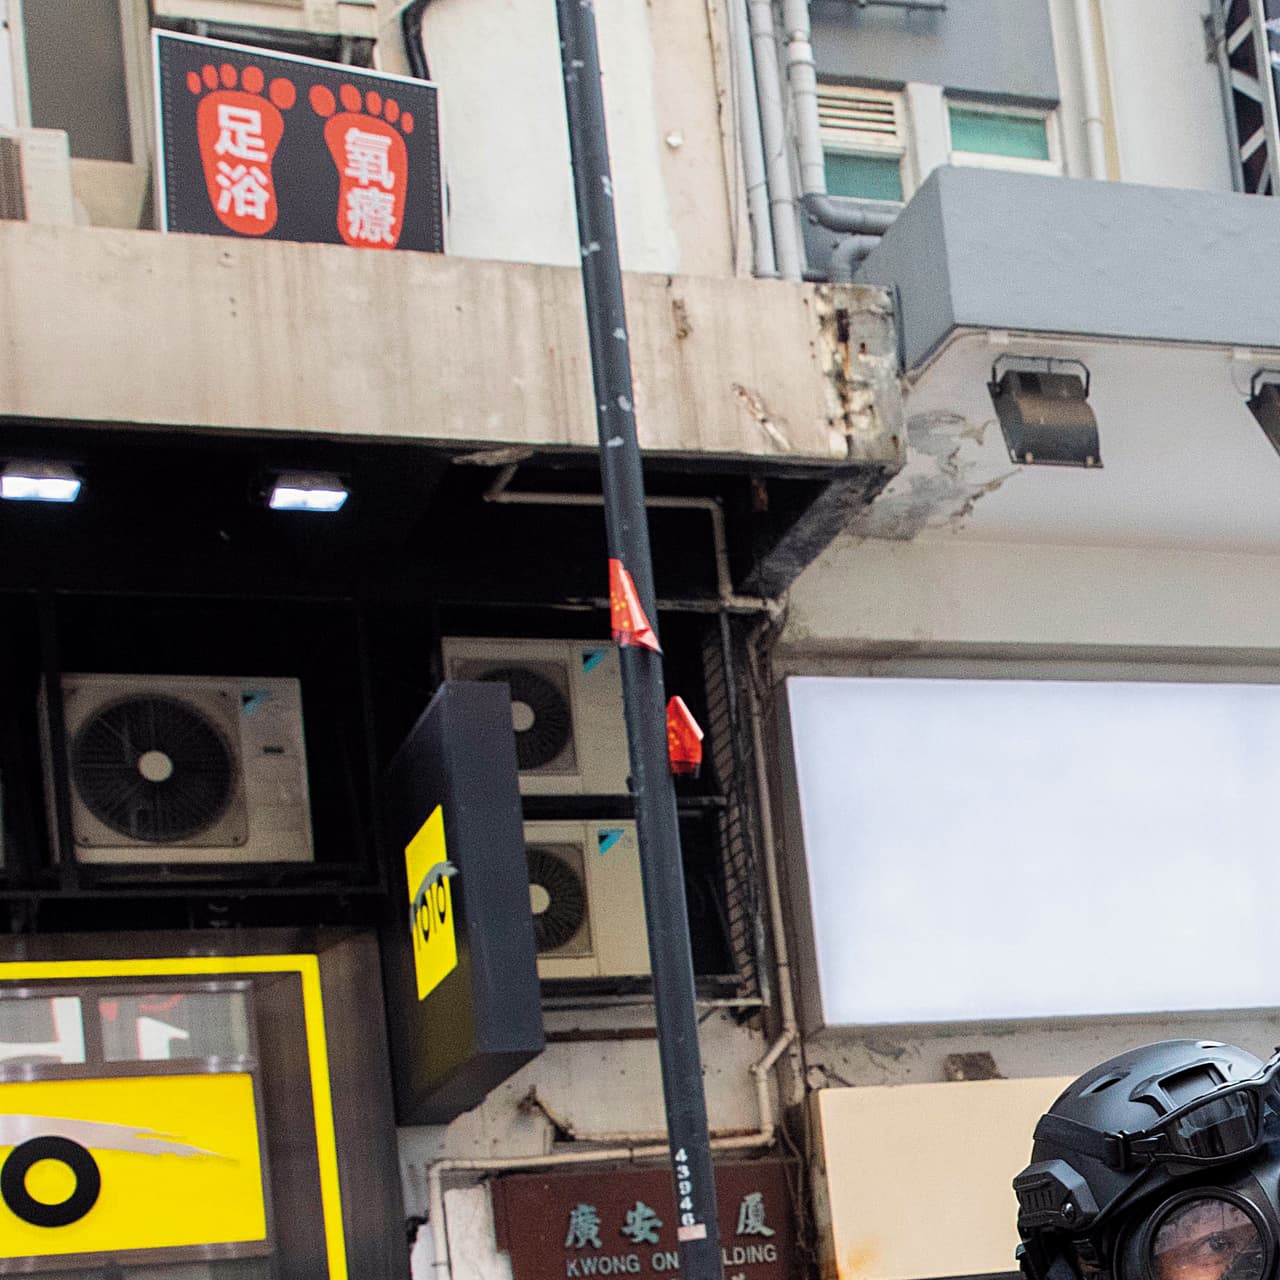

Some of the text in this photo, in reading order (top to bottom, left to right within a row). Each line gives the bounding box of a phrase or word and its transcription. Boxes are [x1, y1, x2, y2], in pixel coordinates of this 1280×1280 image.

[214, 103, 270, 221] 足浴
[344, 127, 397, 244] 氧療
[675, 1147, 695, 1226] 43946
[566, 1245, 778, 1278] KWONG ON LDING
